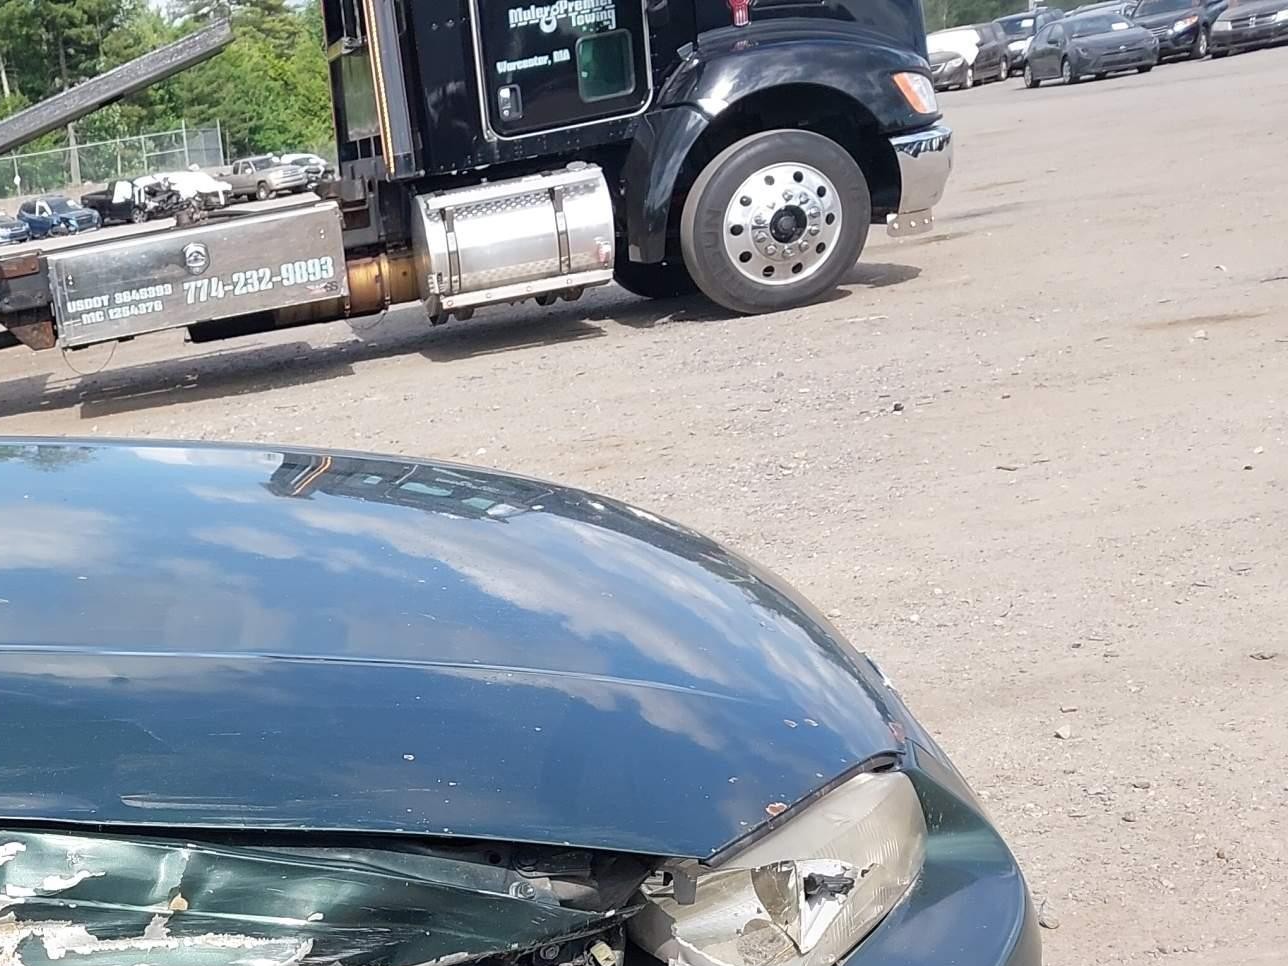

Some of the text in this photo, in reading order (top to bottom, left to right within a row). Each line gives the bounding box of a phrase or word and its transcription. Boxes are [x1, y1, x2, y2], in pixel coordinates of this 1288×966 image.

[568, 9, 616, 30] Towing
[553, 49, 571, 62] MA
[183, 256, 335, 305] 774-232-9893
[67, 294, 110, 313] USDOT
[81, 311, 105, 325] MC
